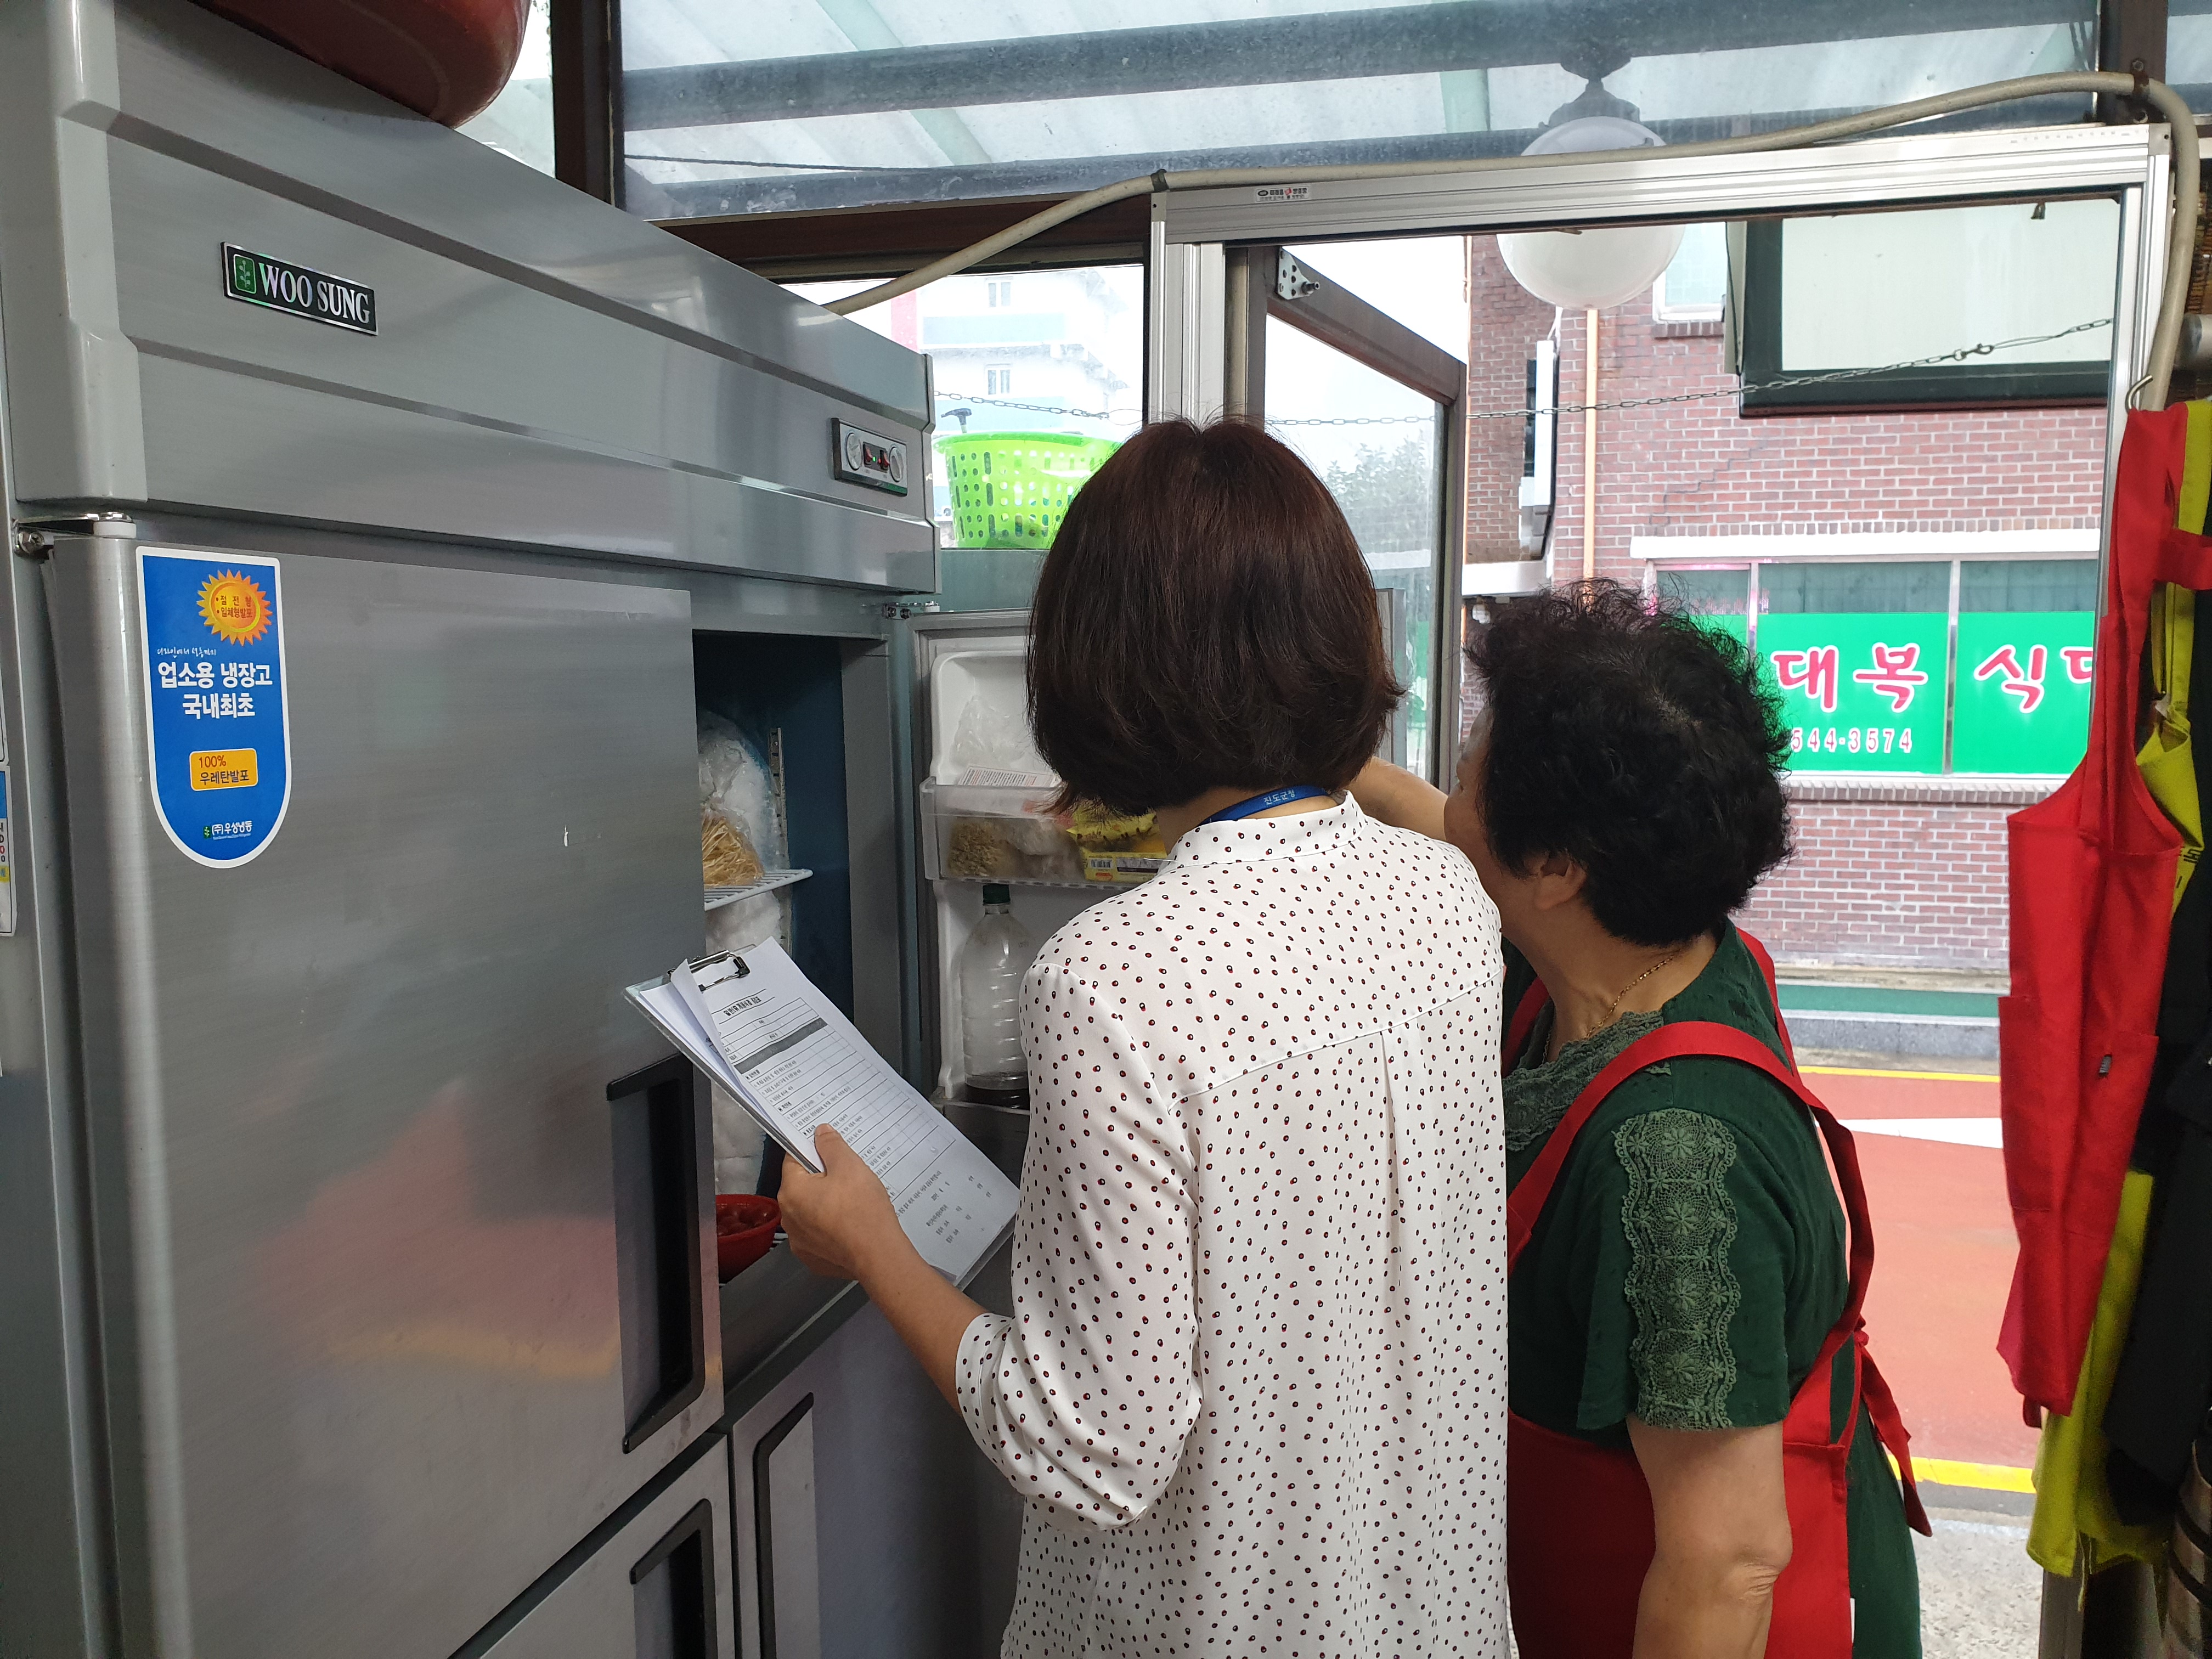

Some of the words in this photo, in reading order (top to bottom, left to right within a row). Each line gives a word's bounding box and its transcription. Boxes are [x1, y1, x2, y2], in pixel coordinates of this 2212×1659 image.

[258, 262, 313, 308] WOO
[317, 280, 370, 324] SUNG
[158, 662, 215, 689] 업소용
[221, 662, 273, 688] 냉장고
[1770, 642, 1928, 713] 대복
[182, 692, 256, 719] 국내최초
[199, 755, 227, 768] 100%
[200, 769, 250, 785] 우레탄발포
[1263, 789, 1295, 805] 진도군청
[212, 820, 252, 836] (주)우성냉동
